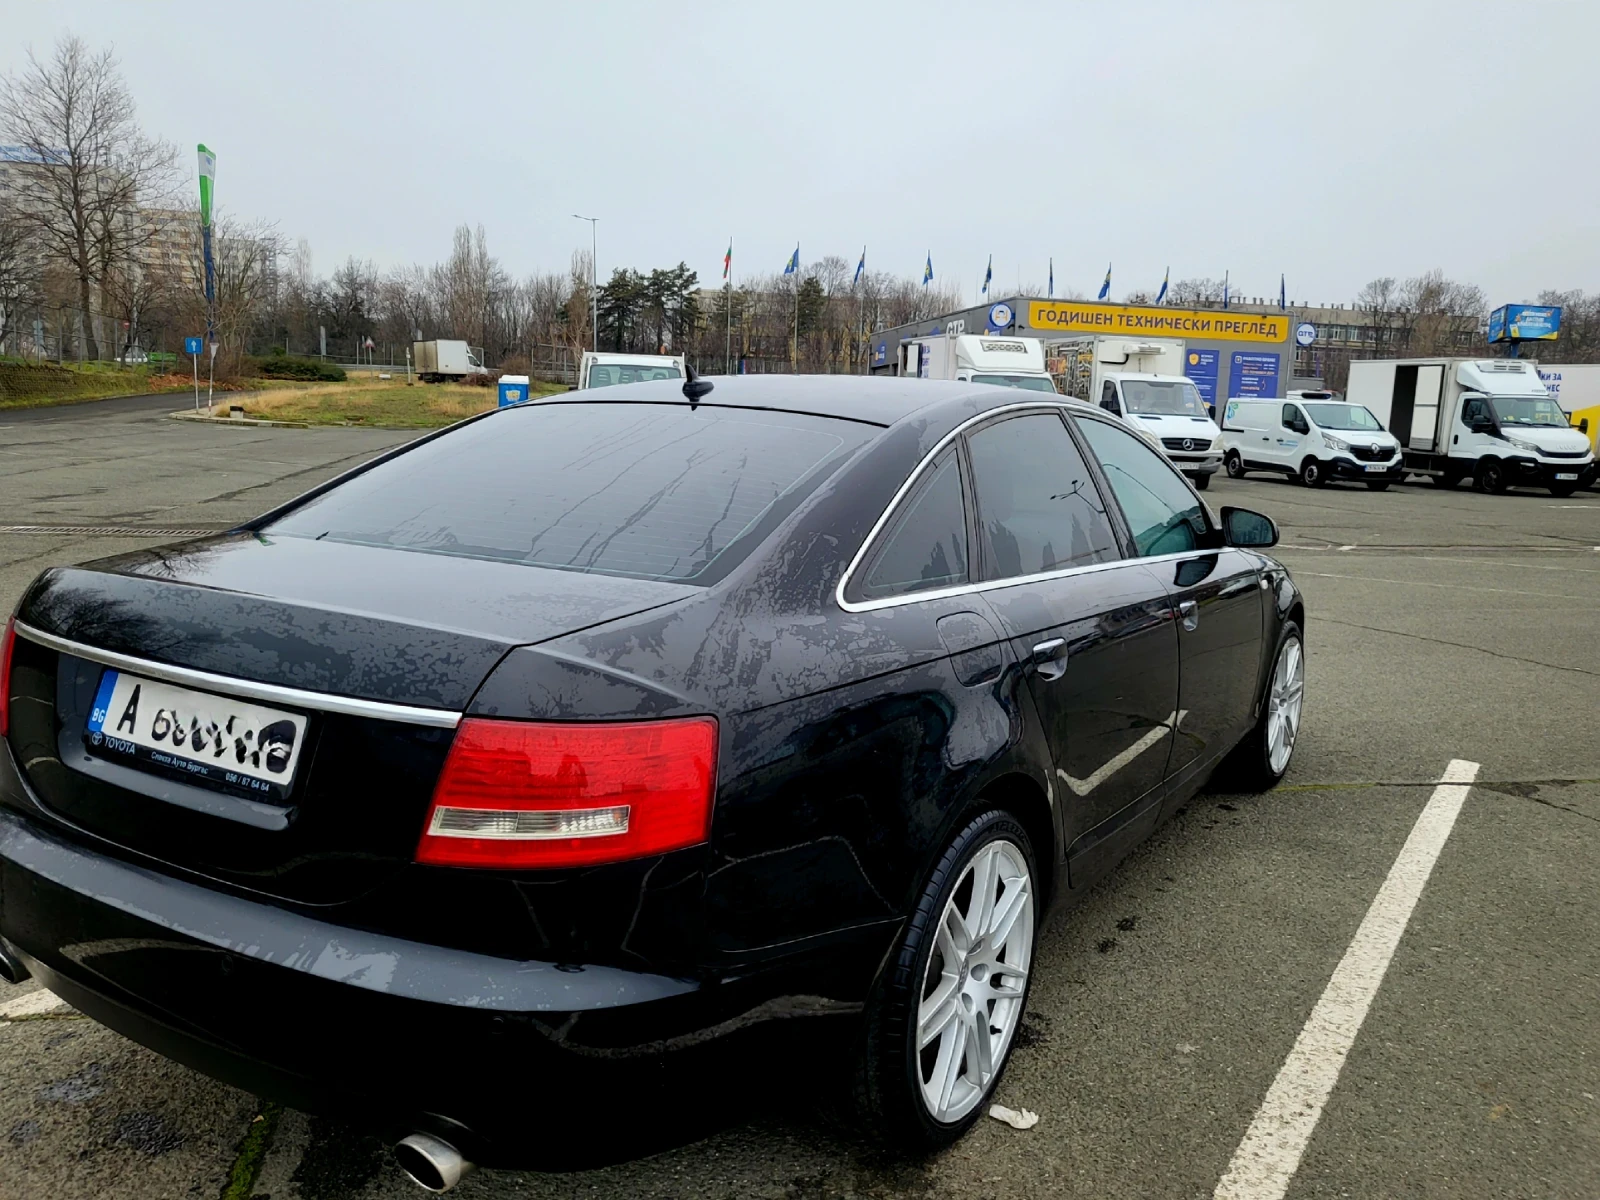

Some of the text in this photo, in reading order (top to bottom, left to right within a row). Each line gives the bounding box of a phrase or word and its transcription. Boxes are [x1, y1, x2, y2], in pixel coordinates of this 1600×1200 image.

[1037, 309, 1277, 338] ГОДИШЕН ТЕХНИЧЕСКИ ПРЕГЛЕД
[91, 707, 106, 723] BG
[105, 736, 135, 754] TOYOTA
[187, 761, 208, 775] Бургас
[241, 776, 251, 787] 87
